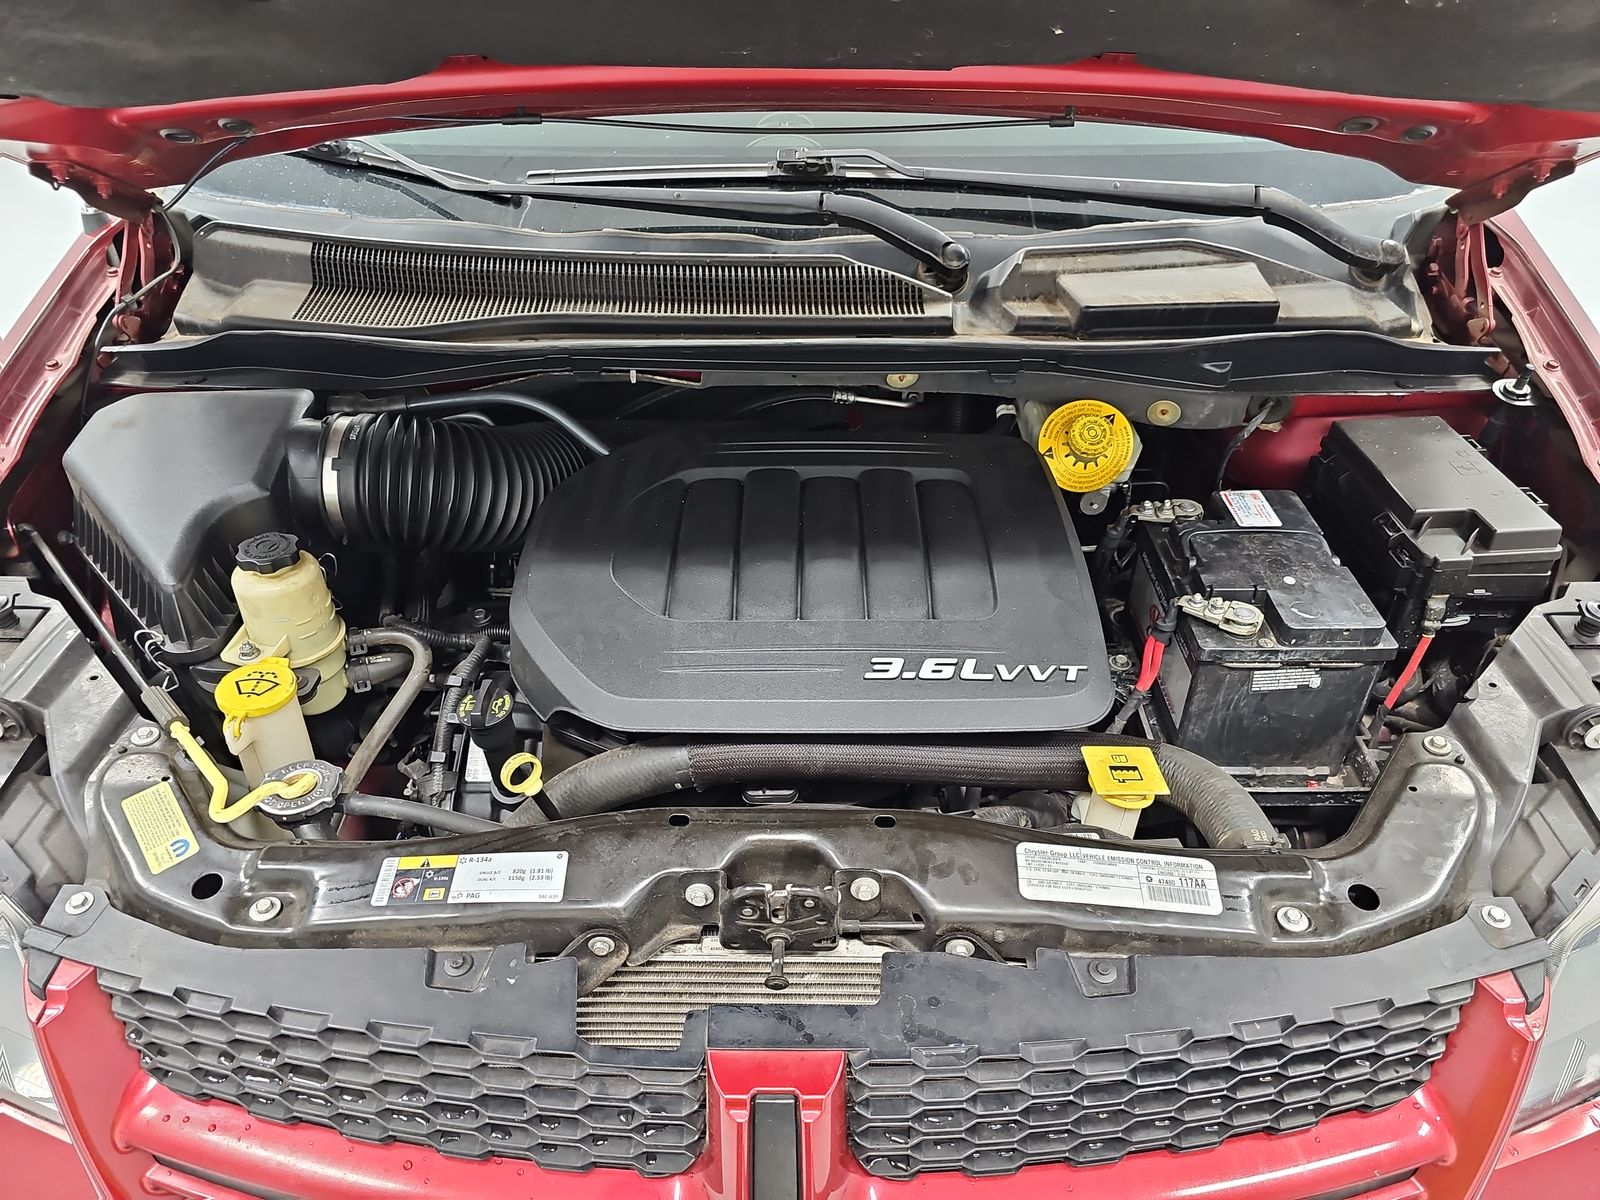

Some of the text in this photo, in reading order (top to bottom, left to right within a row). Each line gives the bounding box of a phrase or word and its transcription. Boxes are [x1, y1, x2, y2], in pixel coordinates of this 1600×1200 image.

[1108, 855, 1134, 864] EMISSION
[1164, 861, 1203, 870] INFORMATION
[1179, 878, 1206, 888] 117AA
